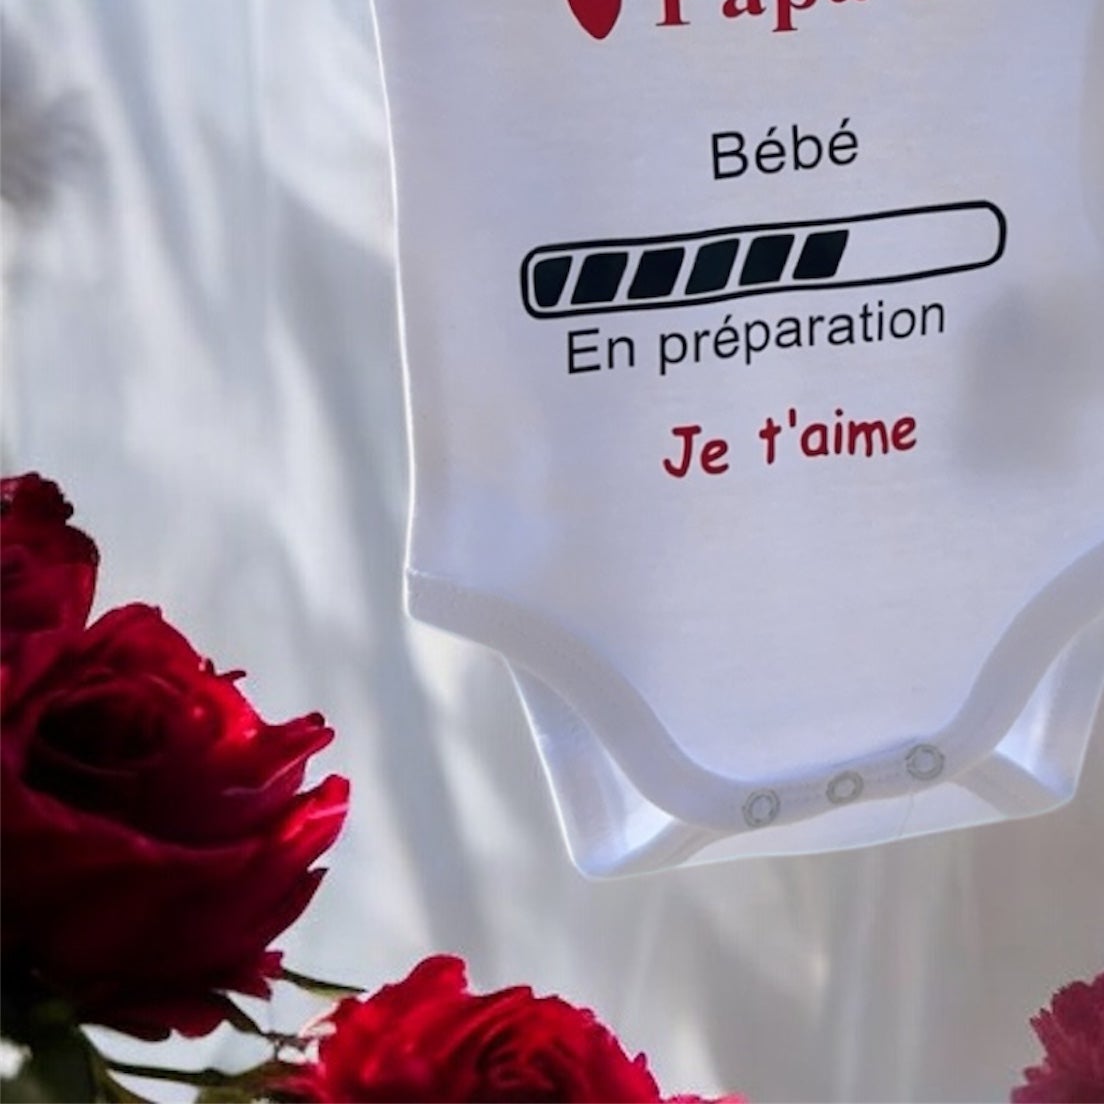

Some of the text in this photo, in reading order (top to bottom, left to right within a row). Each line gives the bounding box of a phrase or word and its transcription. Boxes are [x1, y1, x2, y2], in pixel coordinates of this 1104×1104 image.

[711, 117, 860, 181] Bébé
[567, 298, 945, 377] En préparation
[662, 407, 918, 479] Je t'aime
